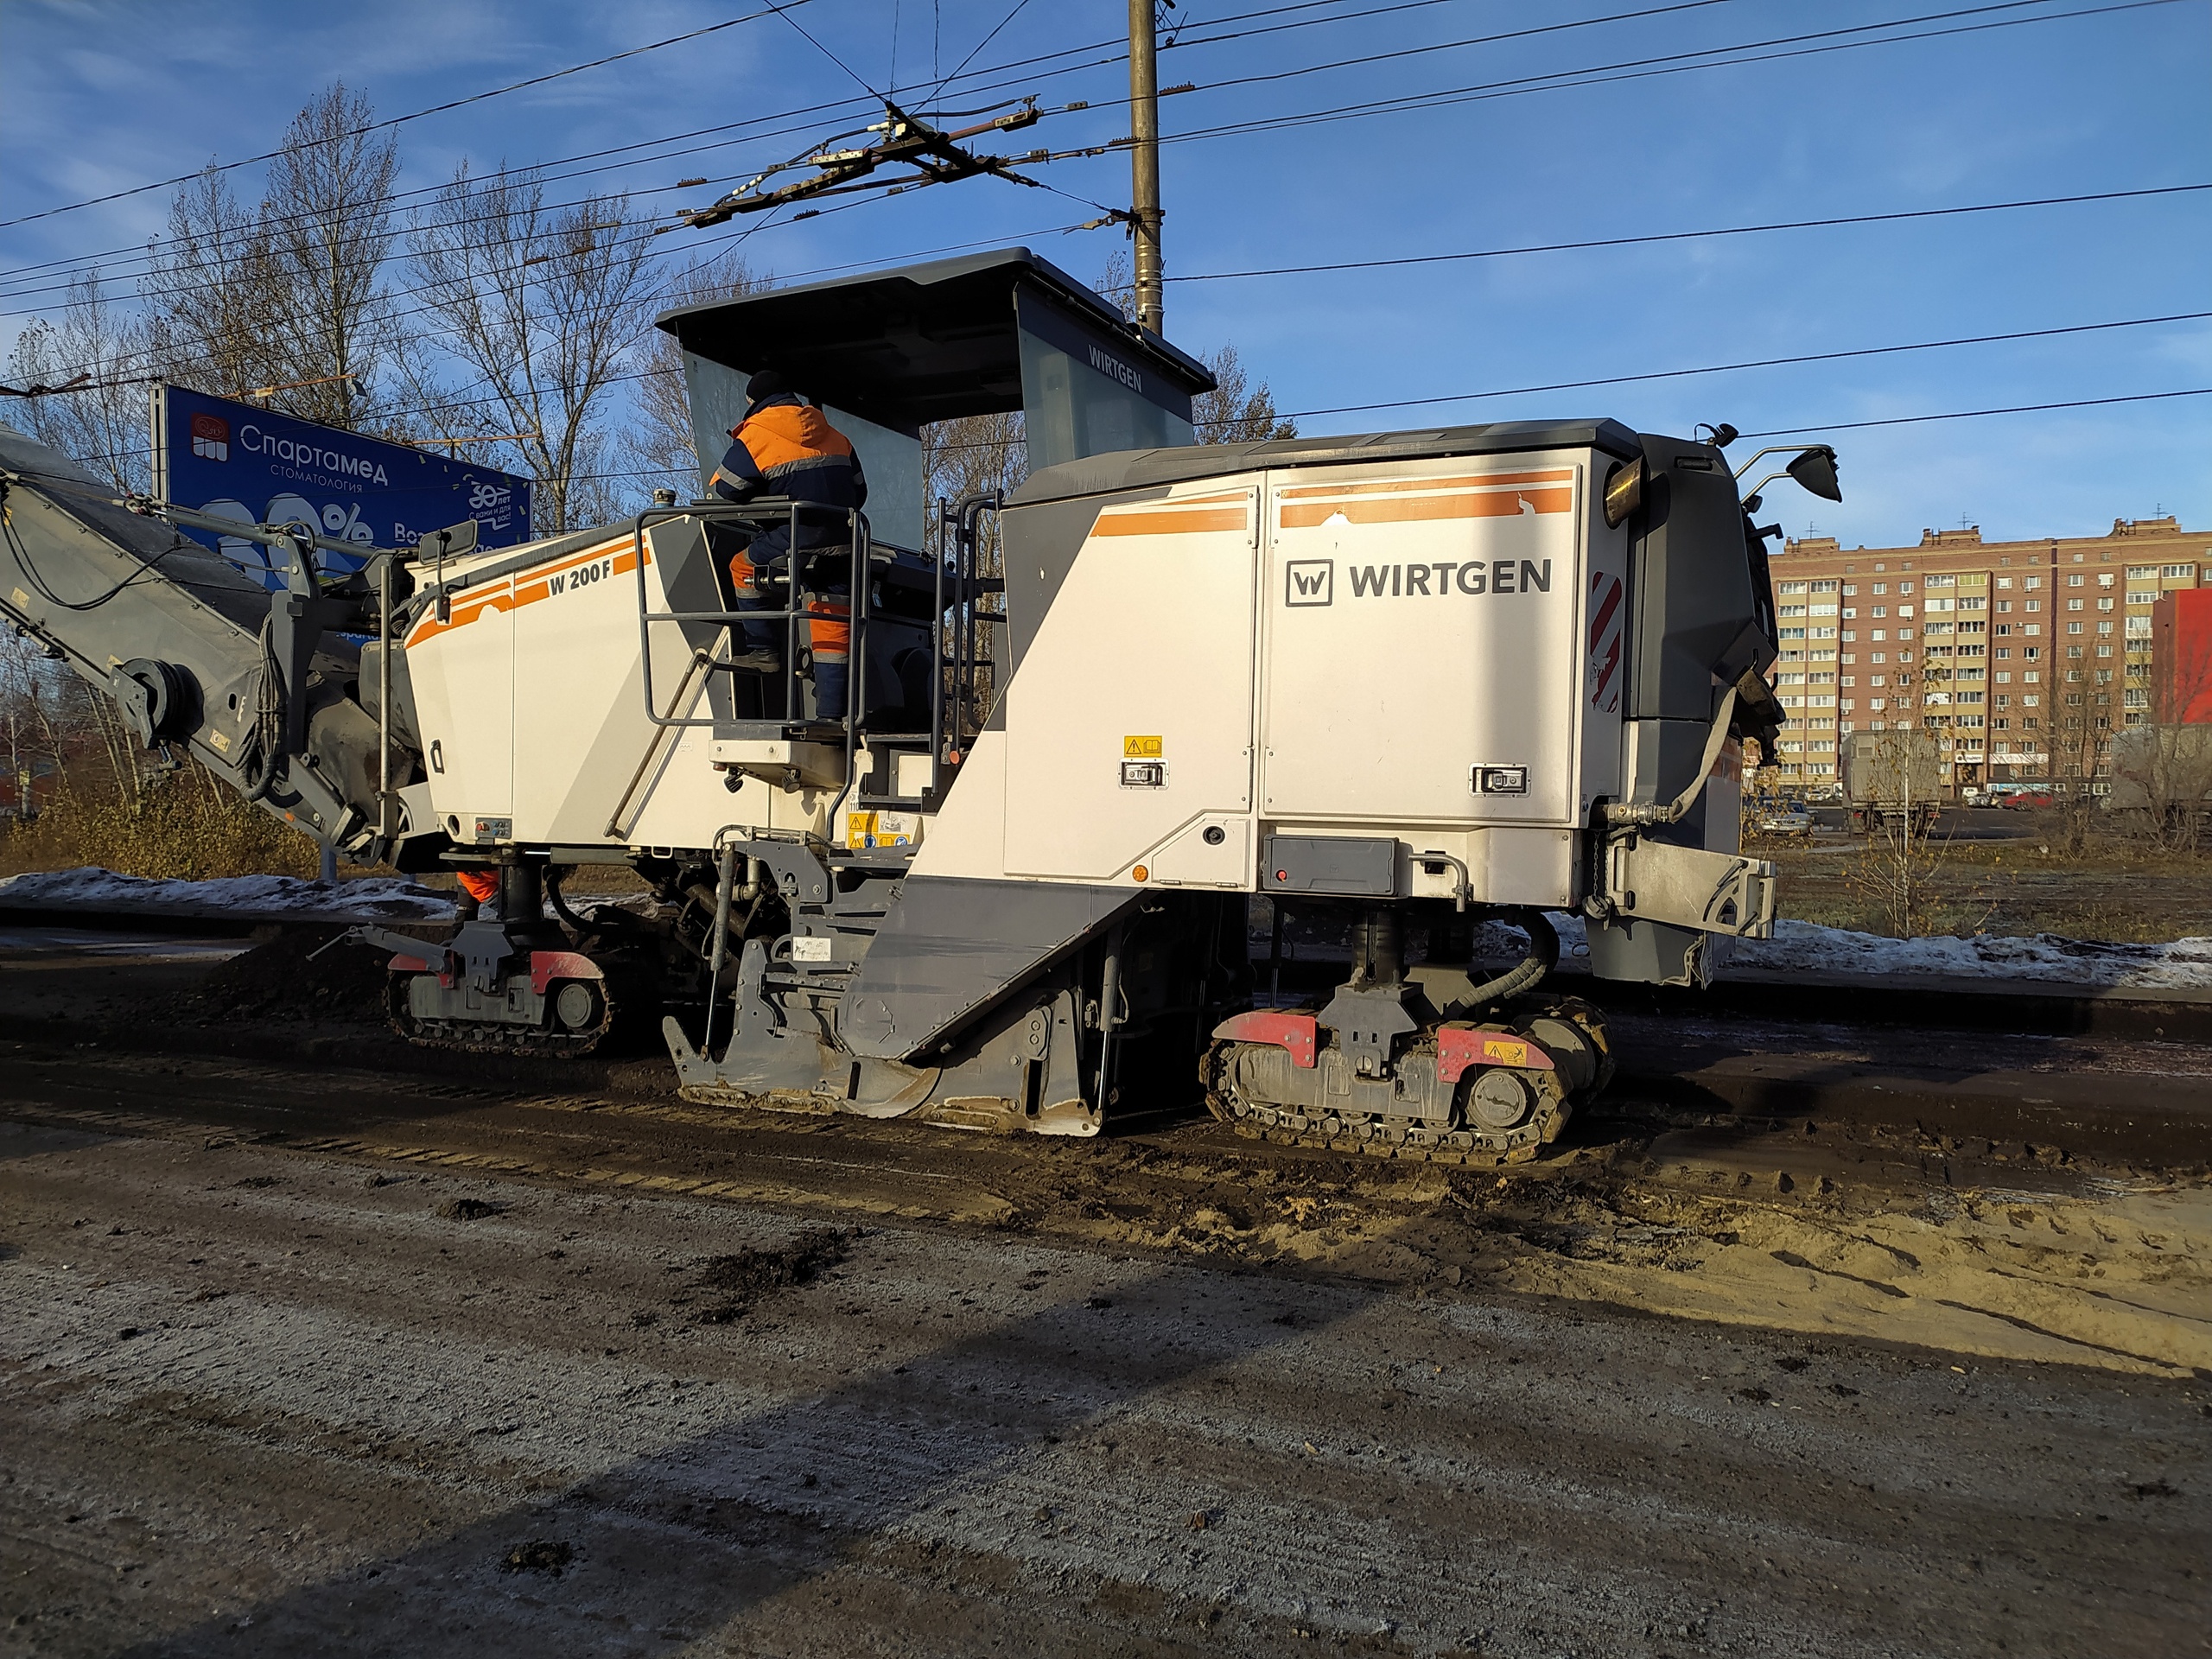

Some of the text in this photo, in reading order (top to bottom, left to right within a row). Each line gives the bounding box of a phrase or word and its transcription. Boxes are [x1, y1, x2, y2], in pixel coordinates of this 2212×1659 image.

[1088, 344, 1142, 393] WIRTGEN
[240, 424, 388, 486] Спартамед
[270, 464, 363, 493] СТОМАТОЛОГИЯ
[498, 495, 512, 505] лет
[550, 574, 565, 596] W
[1350, 558, 1552, 598] WIRTGEN
